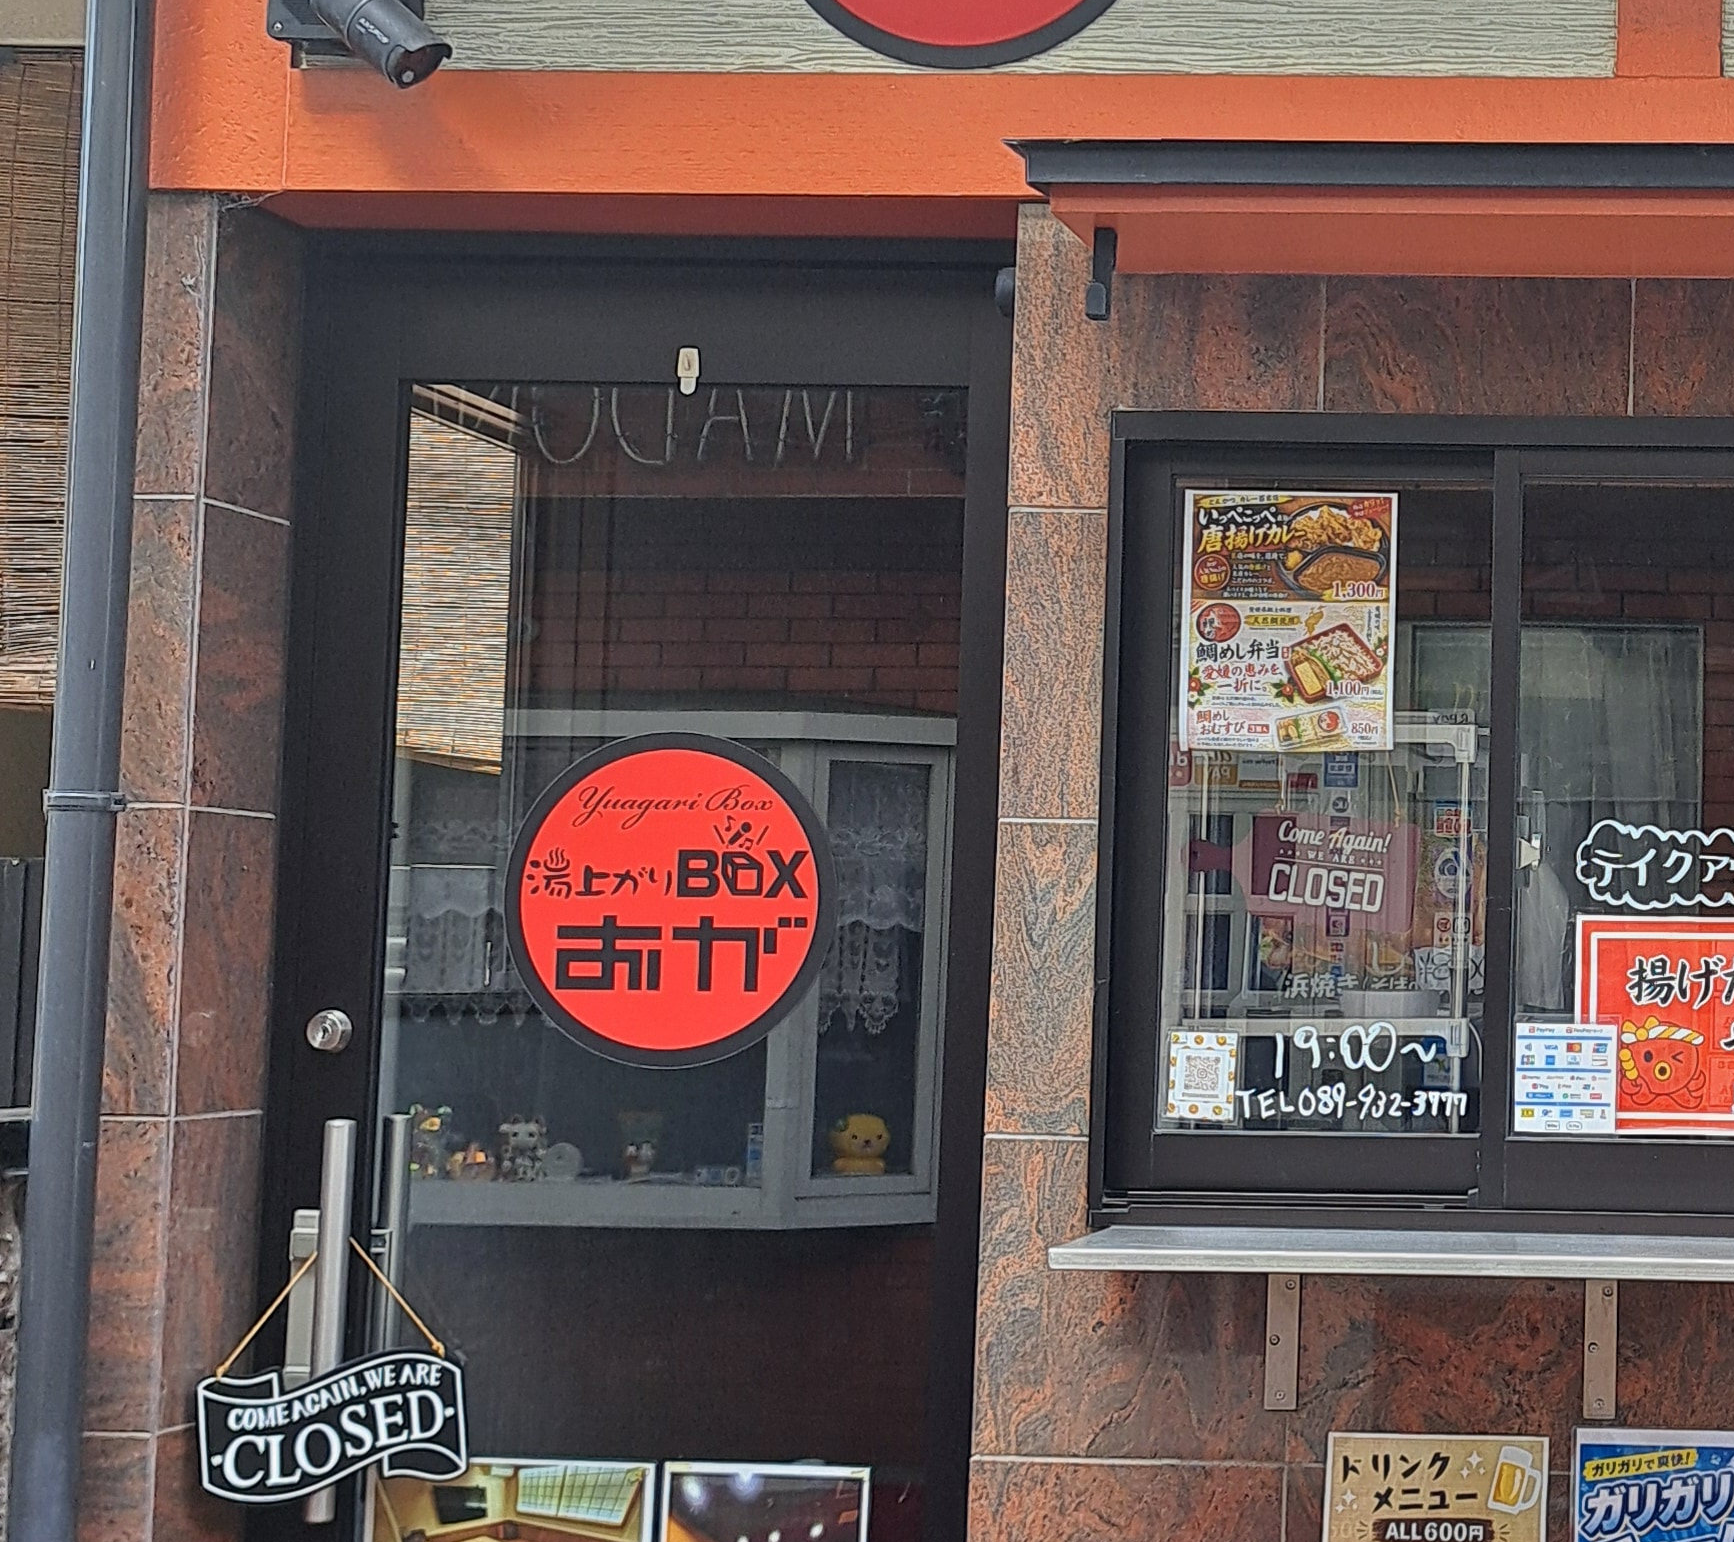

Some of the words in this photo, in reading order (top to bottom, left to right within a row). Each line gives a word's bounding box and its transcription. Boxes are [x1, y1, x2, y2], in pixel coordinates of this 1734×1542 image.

[1198, 524, 1307, 553] 唐揚げカレー
[574, 785, 704, 829] Yuagari
[705, 785, 774, 812] Box
[1278, 820, 1325, 846] Come
[1329, 826, 1392, 855] Again!
[1307, 850, 1324, 861] WE
[1332, 854, 1355, 864] ARE
[1268, 863, 1384, 913] CLOSED
[555, 914, 808, 992] おが
[227, 1403, 290, 1432] COME
[364, 1365, 397, 1391] WE
[399, 1363, 443, 1387] ARE
[223, 1389, 445, 1490] CLOSED
[1342, 1452, 1451, 1482] ドリンク
[1372, 1486, 1478, 1513] メニュー
